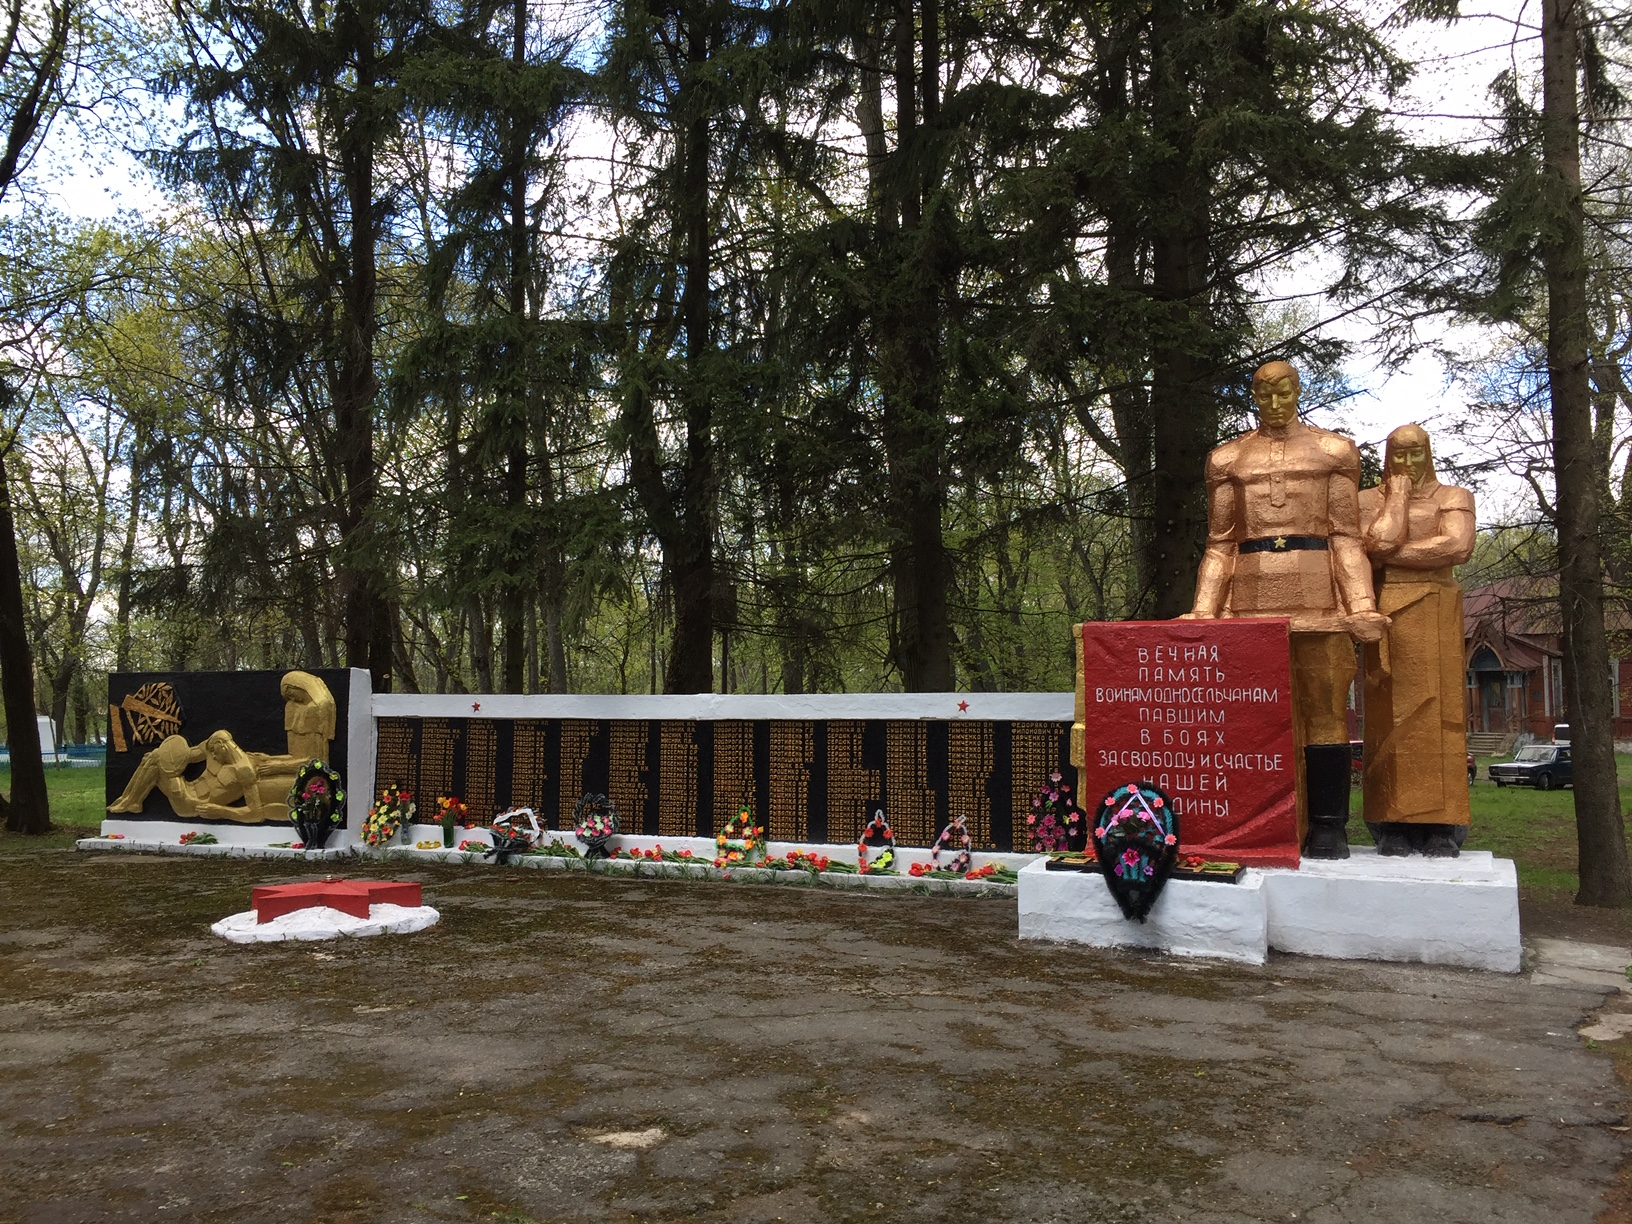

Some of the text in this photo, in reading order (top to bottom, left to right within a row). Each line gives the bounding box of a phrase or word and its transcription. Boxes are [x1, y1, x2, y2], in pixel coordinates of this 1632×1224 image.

[1138, 645, 1218, 663] ВЕЧНАЯ
[1139, 666, 1225, 682] ПАМЯТЬ
[1140, 708, 1225, 724] ПАВШИМ
[1140, 728, 1225, 746] В БОЯХ
[1214, 752, 1284, 771] СЧАСТЬЕ
[1172, 797, 1228, 817] ДИНЫ
